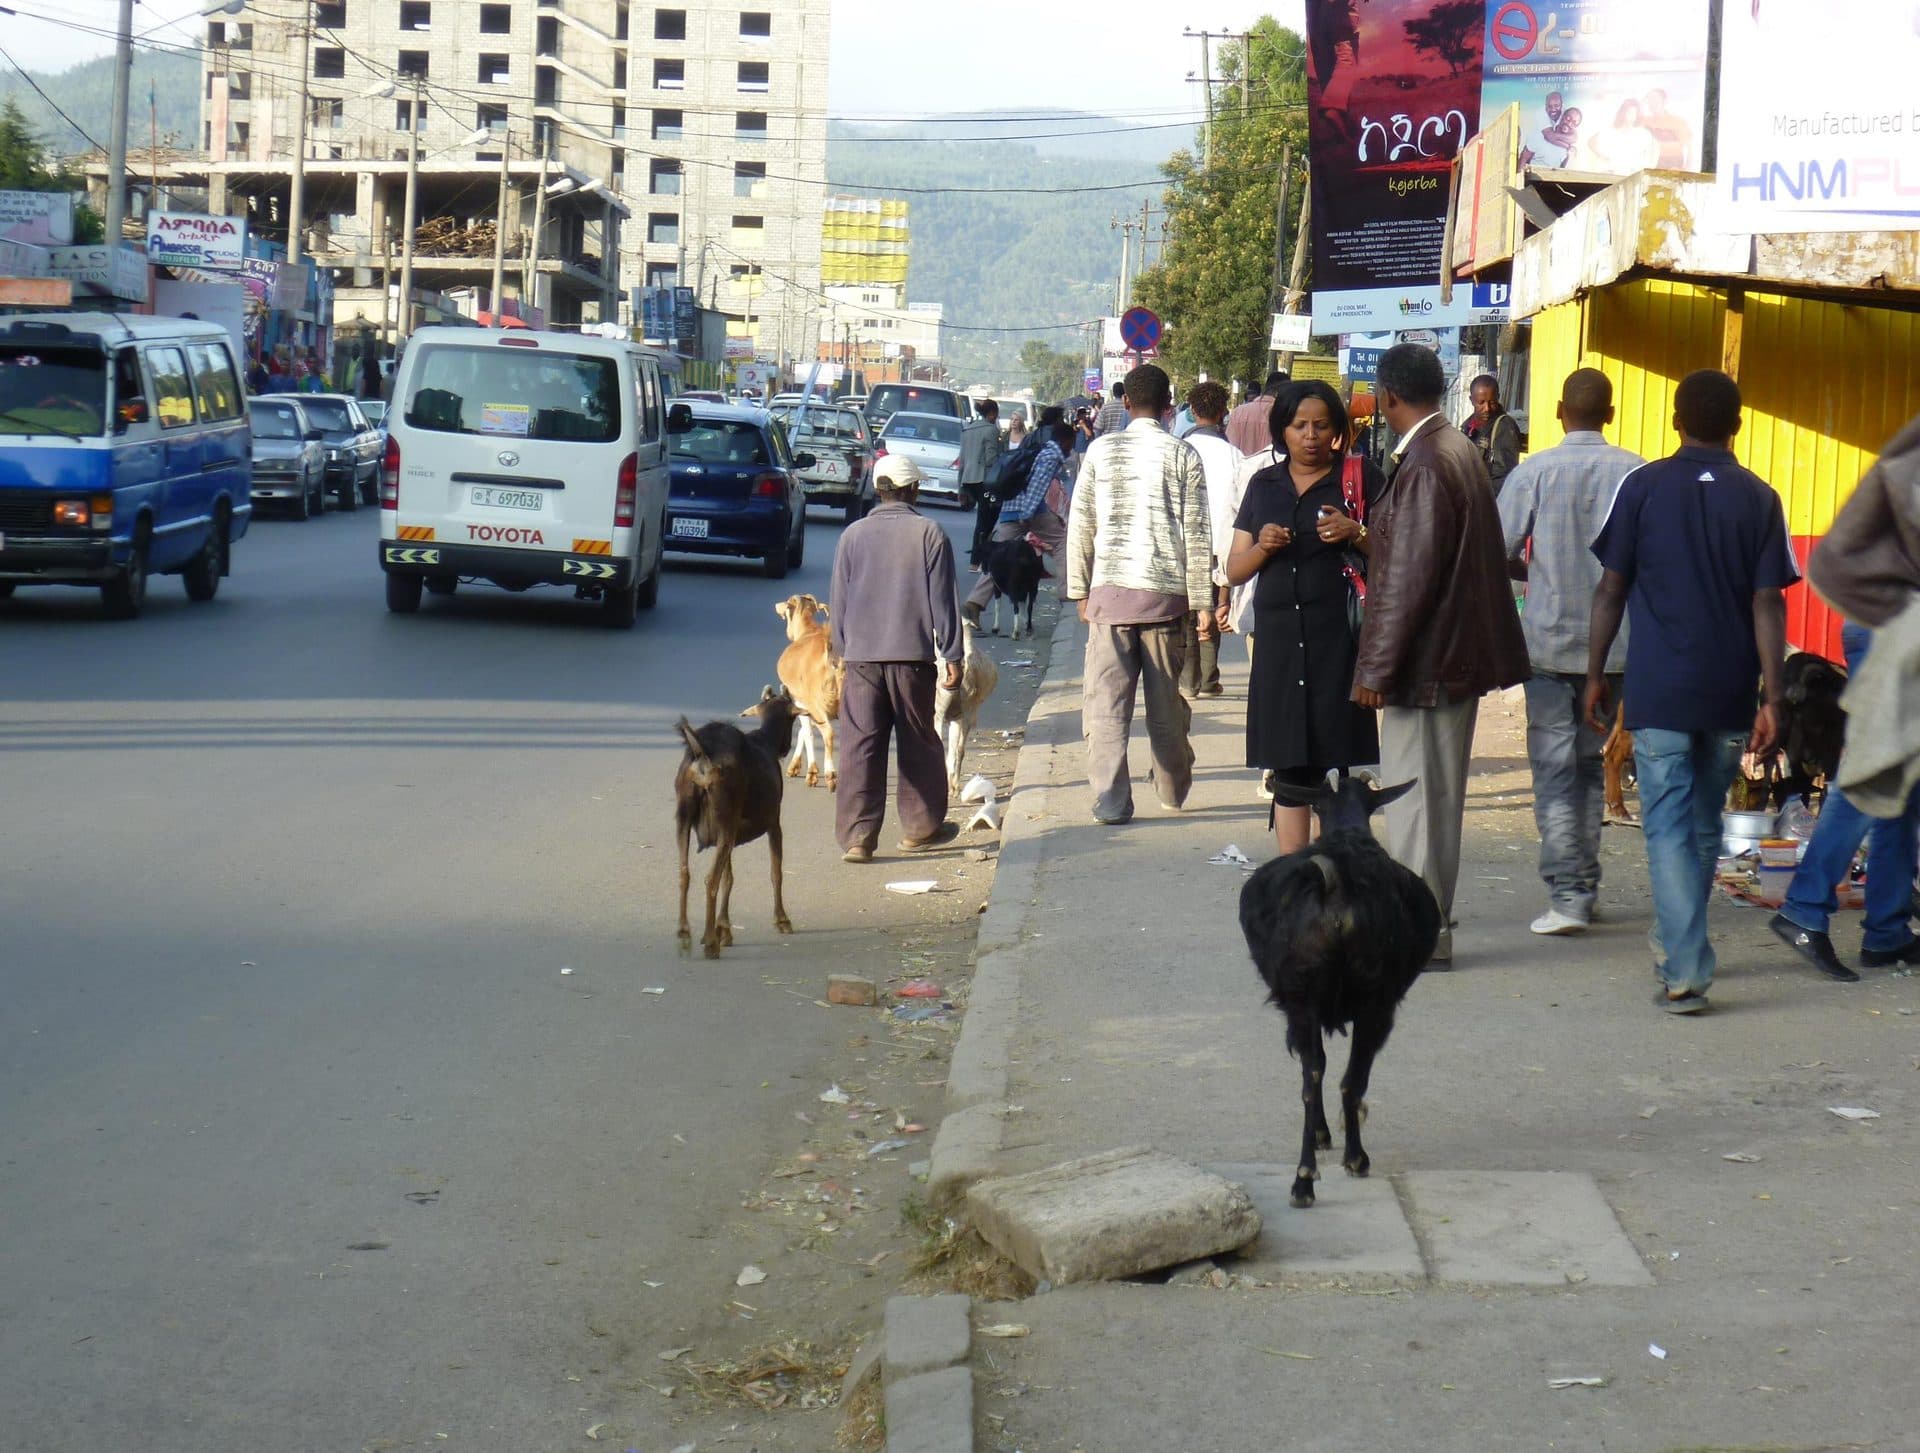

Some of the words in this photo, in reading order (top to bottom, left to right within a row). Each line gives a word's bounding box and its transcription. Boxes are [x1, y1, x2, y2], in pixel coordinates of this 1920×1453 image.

[1773, 112, 1902, 137] Manufactured
[1389, 175, 1438, 197] kejerba
[158, 216, 236, 235] አምባሰል
[203, 250, 240, 265] STUDIO
[1342, 310, 1373, 318] PRODUCTION
[498, 492, 535, 509] 69703
[467, 525, 544, 545] TOYOTA
[673, 524, 706, 537] A10396
